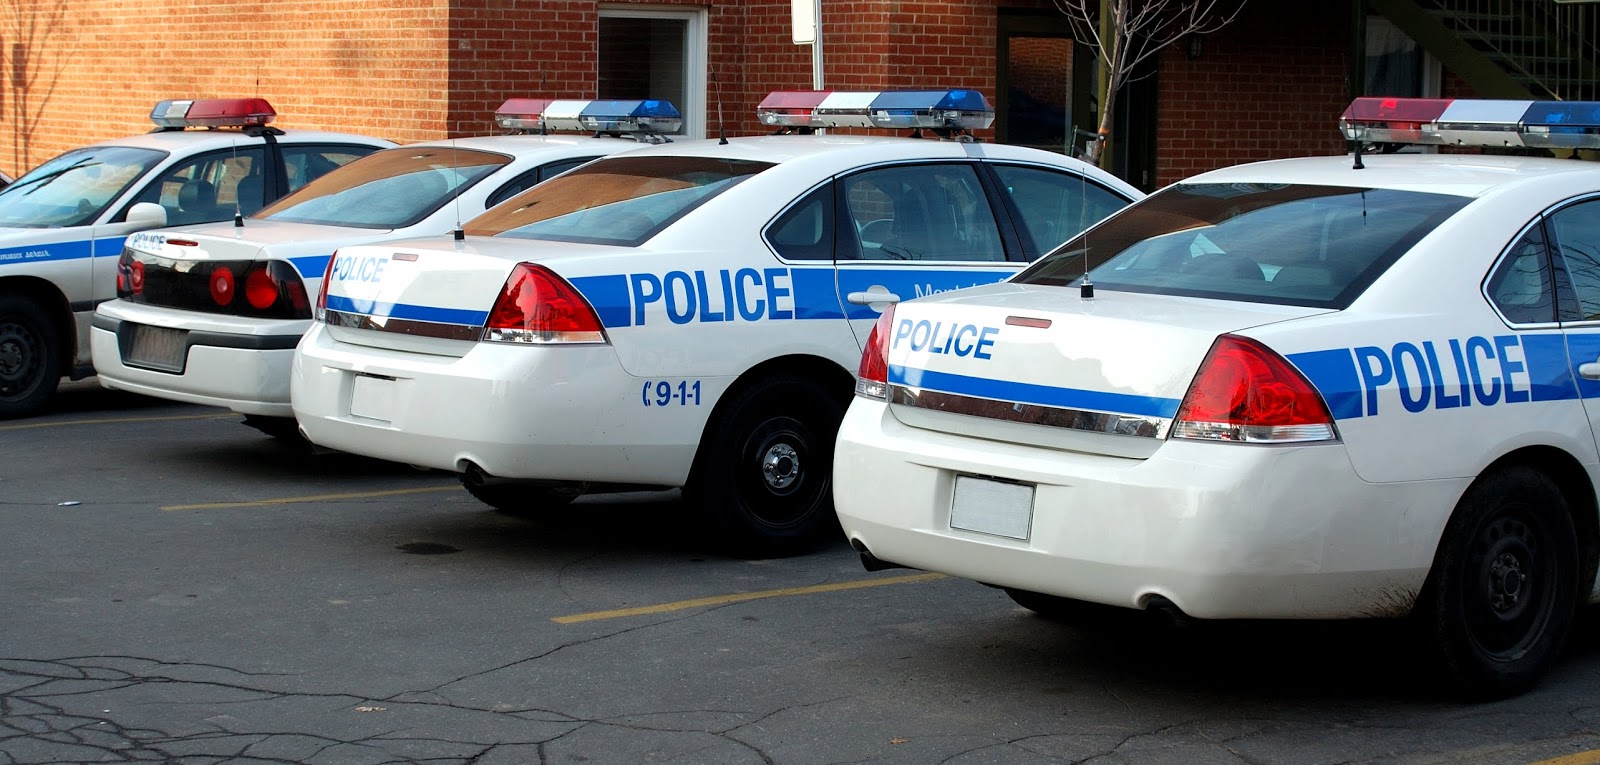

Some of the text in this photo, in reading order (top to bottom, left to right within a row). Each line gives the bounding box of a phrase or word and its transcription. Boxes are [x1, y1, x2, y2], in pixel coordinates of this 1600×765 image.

[132, 233, 165, 250] POLICE
[331, 256, 388, 282] POLICE
[630, 268, 793, 325] POLICE
[893, 319, 1000, 360] POLICE
[1354, 335, 1530, 416] POLICE
[656, 380, 701, 406] 9-1-1
